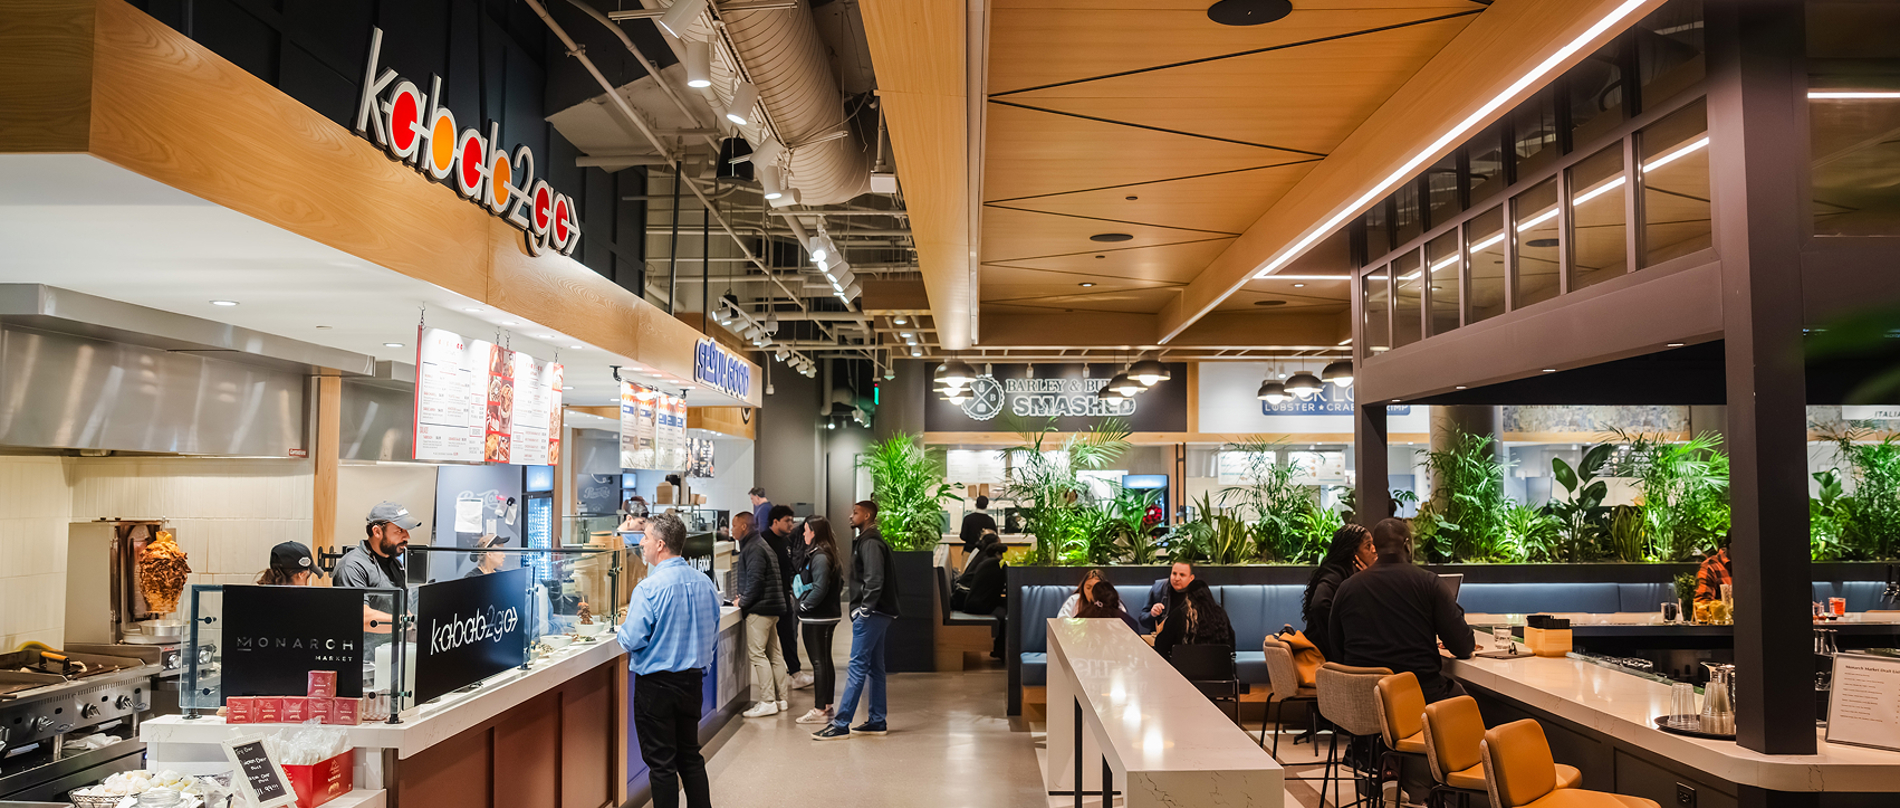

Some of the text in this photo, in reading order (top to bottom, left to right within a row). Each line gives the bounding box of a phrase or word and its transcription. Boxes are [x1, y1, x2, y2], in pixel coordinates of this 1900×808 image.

[355, 25, 570, 258] kabab2go
[727, 356, 750, 398] GOOD
[1006, 379, 1111, 393] BARLEY & BU
[1265, 403, 1315, 411] LOBSTER
[237, 636, 354, 651] MONARCH
[430, 604, 514, 656] kabab2go
